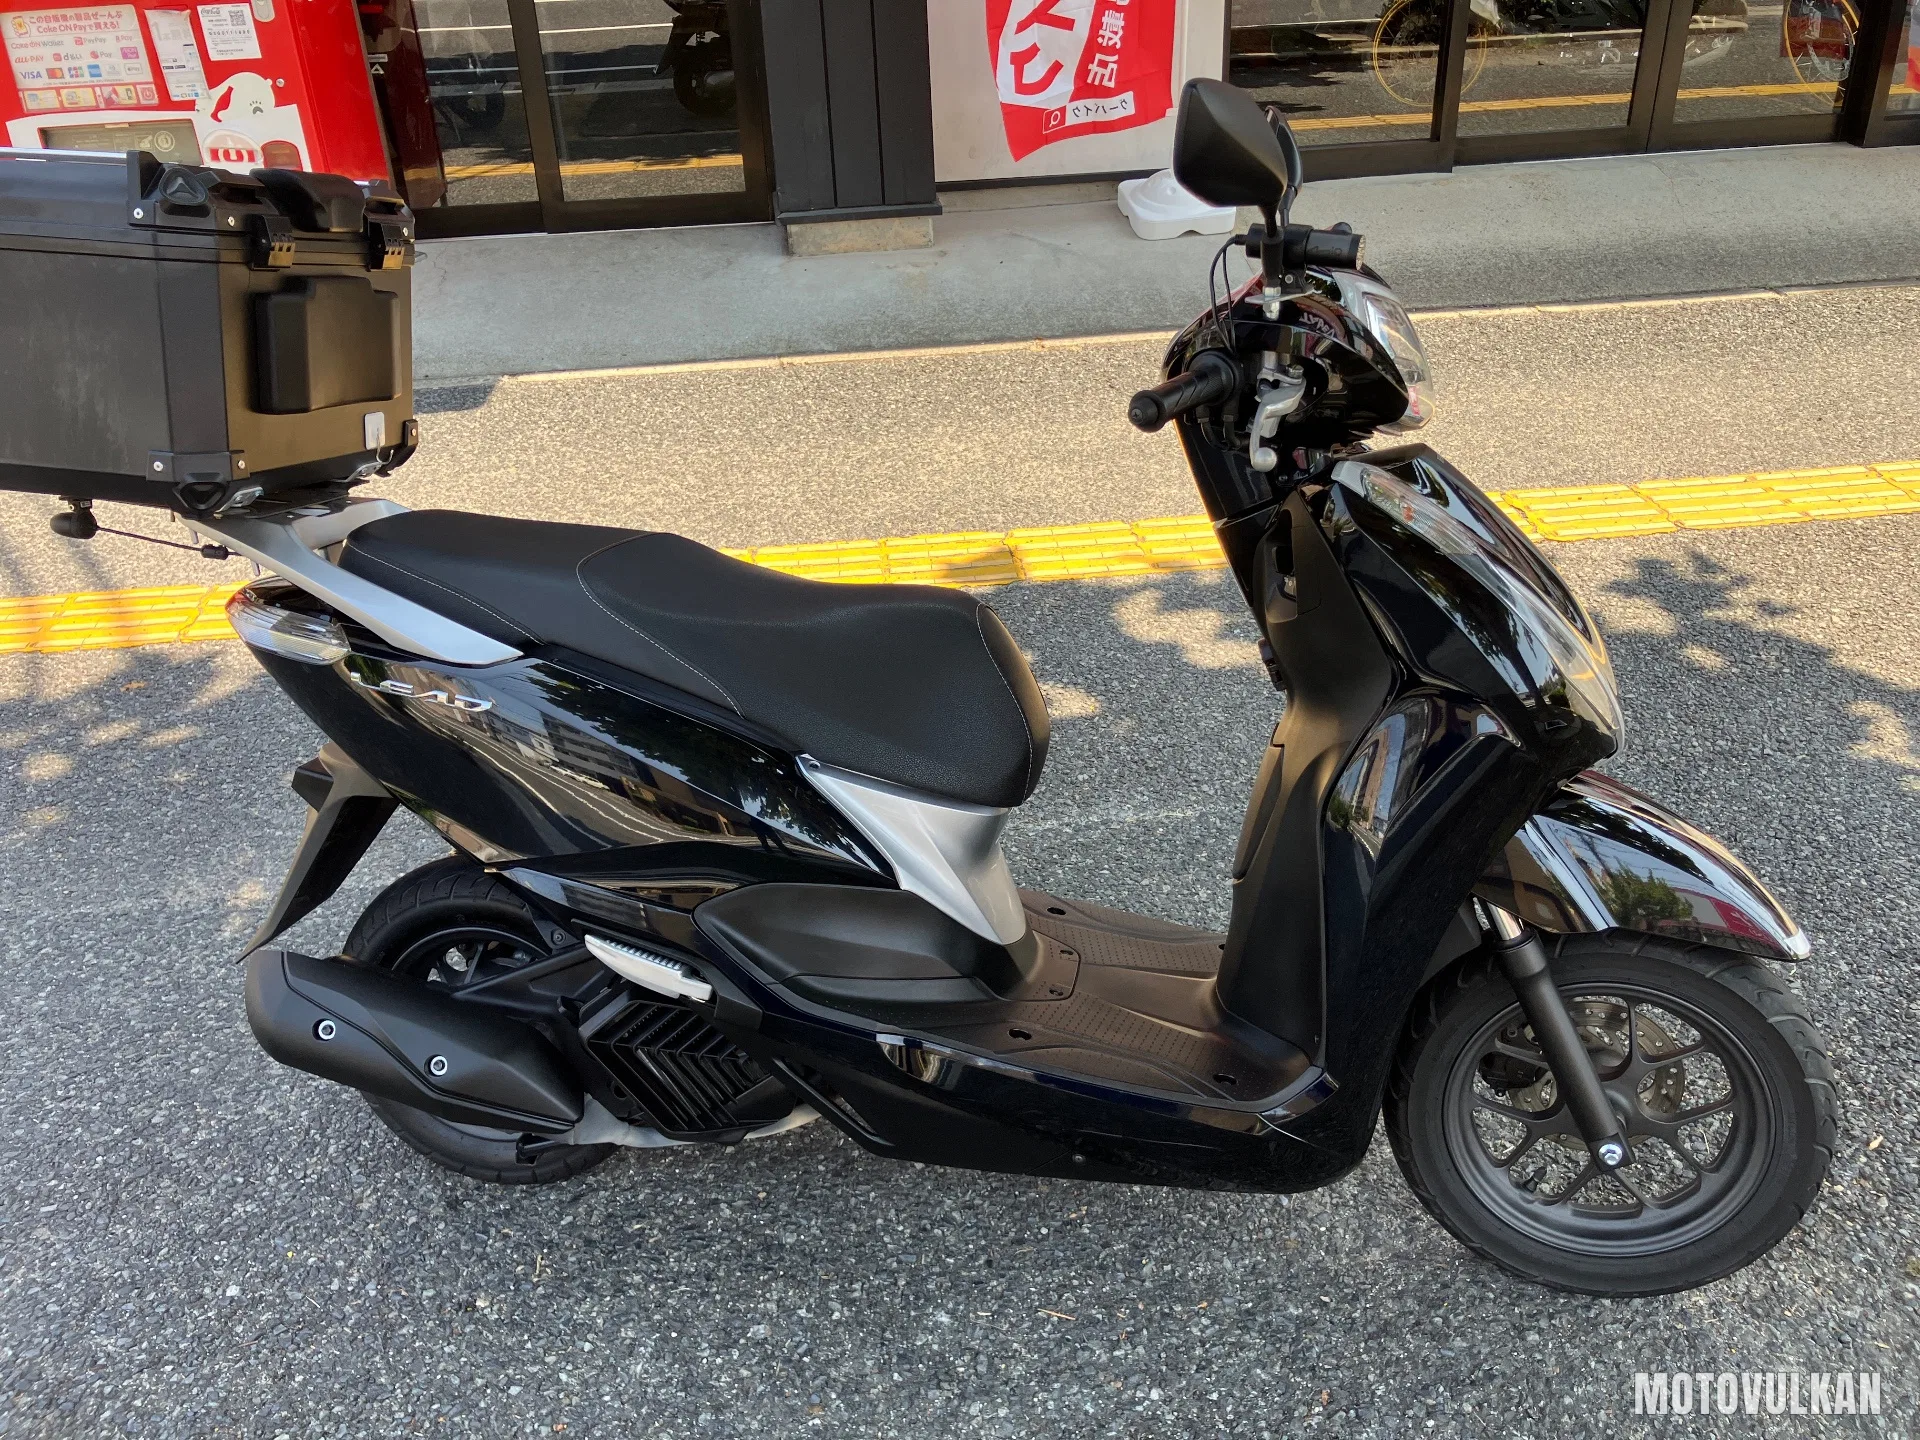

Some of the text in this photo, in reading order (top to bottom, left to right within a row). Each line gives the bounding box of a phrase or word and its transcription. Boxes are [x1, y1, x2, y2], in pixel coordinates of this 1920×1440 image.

[37, 25, 57, 33] Coke
[11, 42, 29, 50] Coke
[20, 70, 43, 79] VISA
[351, 671, 493, 712] LEAD
